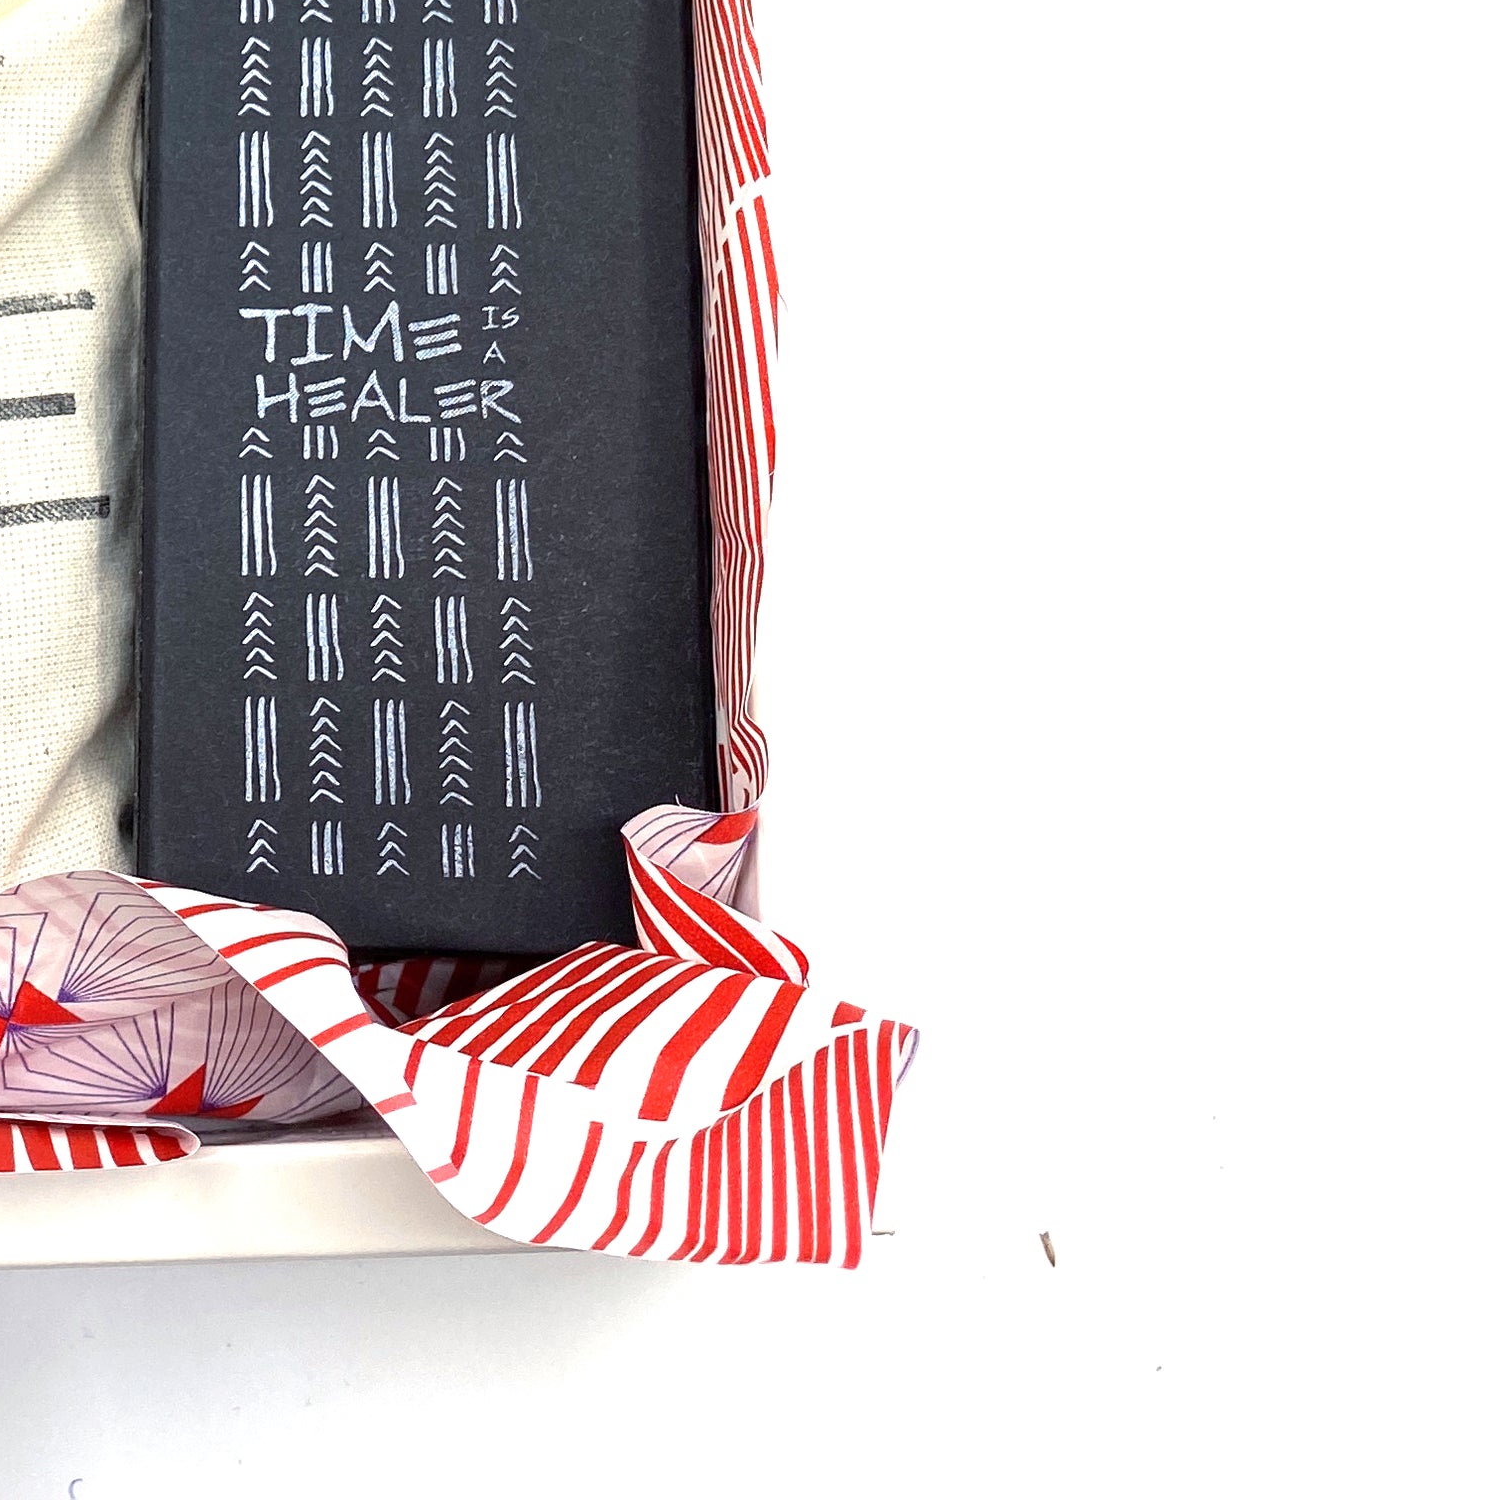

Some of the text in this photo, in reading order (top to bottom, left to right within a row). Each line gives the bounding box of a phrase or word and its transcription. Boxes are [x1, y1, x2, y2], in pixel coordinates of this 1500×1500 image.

[239, 300, 520, 366] TIME IS
[483, 340, 506, 364] A
[255, 369, 521, 424] HEALER
